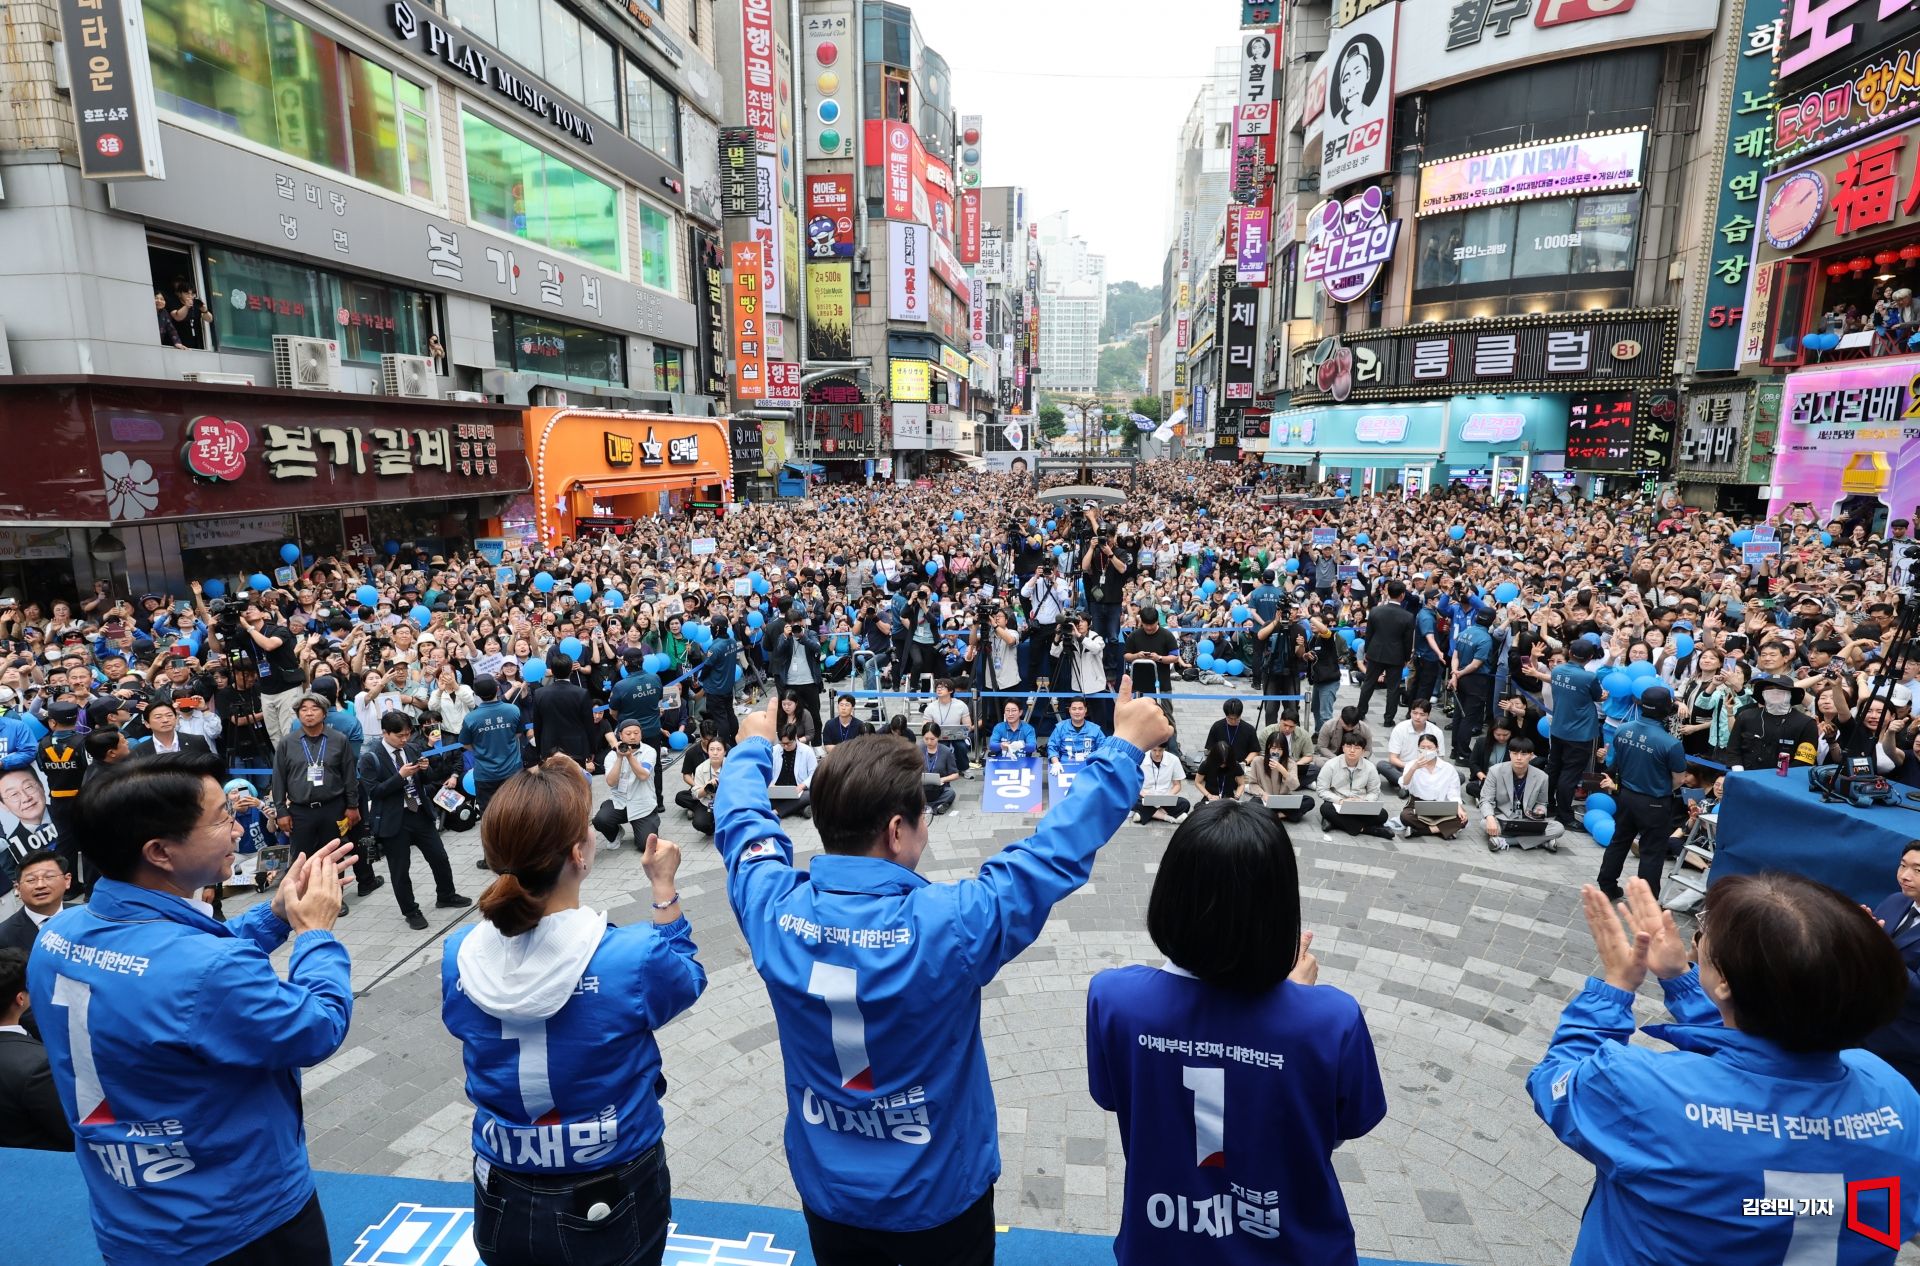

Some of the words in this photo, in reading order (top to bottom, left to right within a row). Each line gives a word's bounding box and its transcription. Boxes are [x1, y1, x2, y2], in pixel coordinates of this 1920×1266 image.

[808, 18, 846, 30] 스카이
[1252, 10, 1270, 21] 5F
[80, 0, 113, 92] 다운
[428, 20, 490, 84] PLAY
[495, 66, 549, 119] MUSIC
[552, 101, 595, 145] TOWN
[1248, 64, 1266, 102] 철구
[748, 90, 773, 109] 초밥
[1242, 104, 1269, 119] PC
[84, 107, 129, 123] 호프·소주
[748, 108, 773, 129] 참치
[1246, 122, 1262, 133] 3F
[1774, 81, 1852, 151] 도우미
[100, 138, 120, 153] 3층
[757, 142, 769, 150] 2F
[1324, 133, 1350, 166] 철구
[1350, 120, 1383, 153] PC
[1360, 155, 1370, 166] 3F
[1468, 155, 1517, 184] PLAY
[1521, 144, 1580, 175] NEW!
[276, 173, 347, 217] 갈비탕
[1423, 195, 1442, 207] 신개념
[1443, 191, 1469, 204] 노래게임
[1474, 184, 1510, 198] 모두의대결
[1597, 168, 1634, 181] 게임/선물
[1714, 91, 1774, 285] 노래연습장
[1244, 210, 1264, 220] 코인
[280, 214, 349, 253] 냉면
[1533, 232, 1582, 250] 1,000원
[1305, 222, 1399, 278] 논다코인
[1453, 242, 1507, 262] 코인노래방
[1239, 262, 1264, 270] 노래방
[739, 273, 760, 381] 대빵오락실
[1707, 305, 1744, 329] 5F
[1230, 302, 1255, 369] 체리
[1413, 329, 1592, 380] 룸클럽
[1614, 342, 1638, 358] B1
[1176, 364, 1185, 384] 치과
[1226, 383, 1252, 398] 노래바
[1695, 397, 1732, 423] 애플
[200, 425, 220, 436] 롯데
[457, 424, 495, 440] 돼지갈비
[744, 430, 760, 443] PLAY
[459, 442, 496, 458] 삼겹살
[606, 434, 634, 463] 대빵
[670, 434, 699, 462] 오락실
[1644, 422, 1670, 467] 체리
[1680, 427, 1733, 464] 노래바
[460, 460, 498, 476] 생등심
[631, 688, 657, 699] POLICE
[1551, 678, 1577, 690] POLICE
[478, 722, 511, 733] POLICE
[1624, 729, 1647, 742] 경찰
[1617, 736, 1654, 754] POLICE
[44, 761, 77, 770] POLICE
[991, 767, 1036, 798] 광
[779, 913, 822, 944] 이제부터
[823, 927, 851, 946] 진짜
[851, 926, 911, 949] 대한민국
[41, 930, 70, 961] 이제부터
[71, 944, 96, 965] 진짜
[96, 950, 150, 977] 대한민국
[807, 960, 875, 1091] 1
[51, 973, 116, 1125] 1
[1138, 1034, 1192, 1058] 이제부터
[1194, 1041, 1225, 1059] 진짜
[1225, 1046, 1285, 1070] 대한민국
[501, 1019, 560, 1125] 1
[870, 1085, 925, 1111] 지금은
[803, 1085, 932, 1145] 이재명
[1182, 1065, 1226, 1168] 1
[1685, 1102, 1781, 1139] 이제부터
[1783, 1115, 1830, 1140] 진짜
[1833, 1105, 1904, 1140] 대한민국
[126, 1119, 183, 1138] 지금은
[482, 1117, 618, 1168] 이재명
[1230, 1182, 1279, 1205] 지금은
[1146, 1192, 1281, 1239] 이재명
